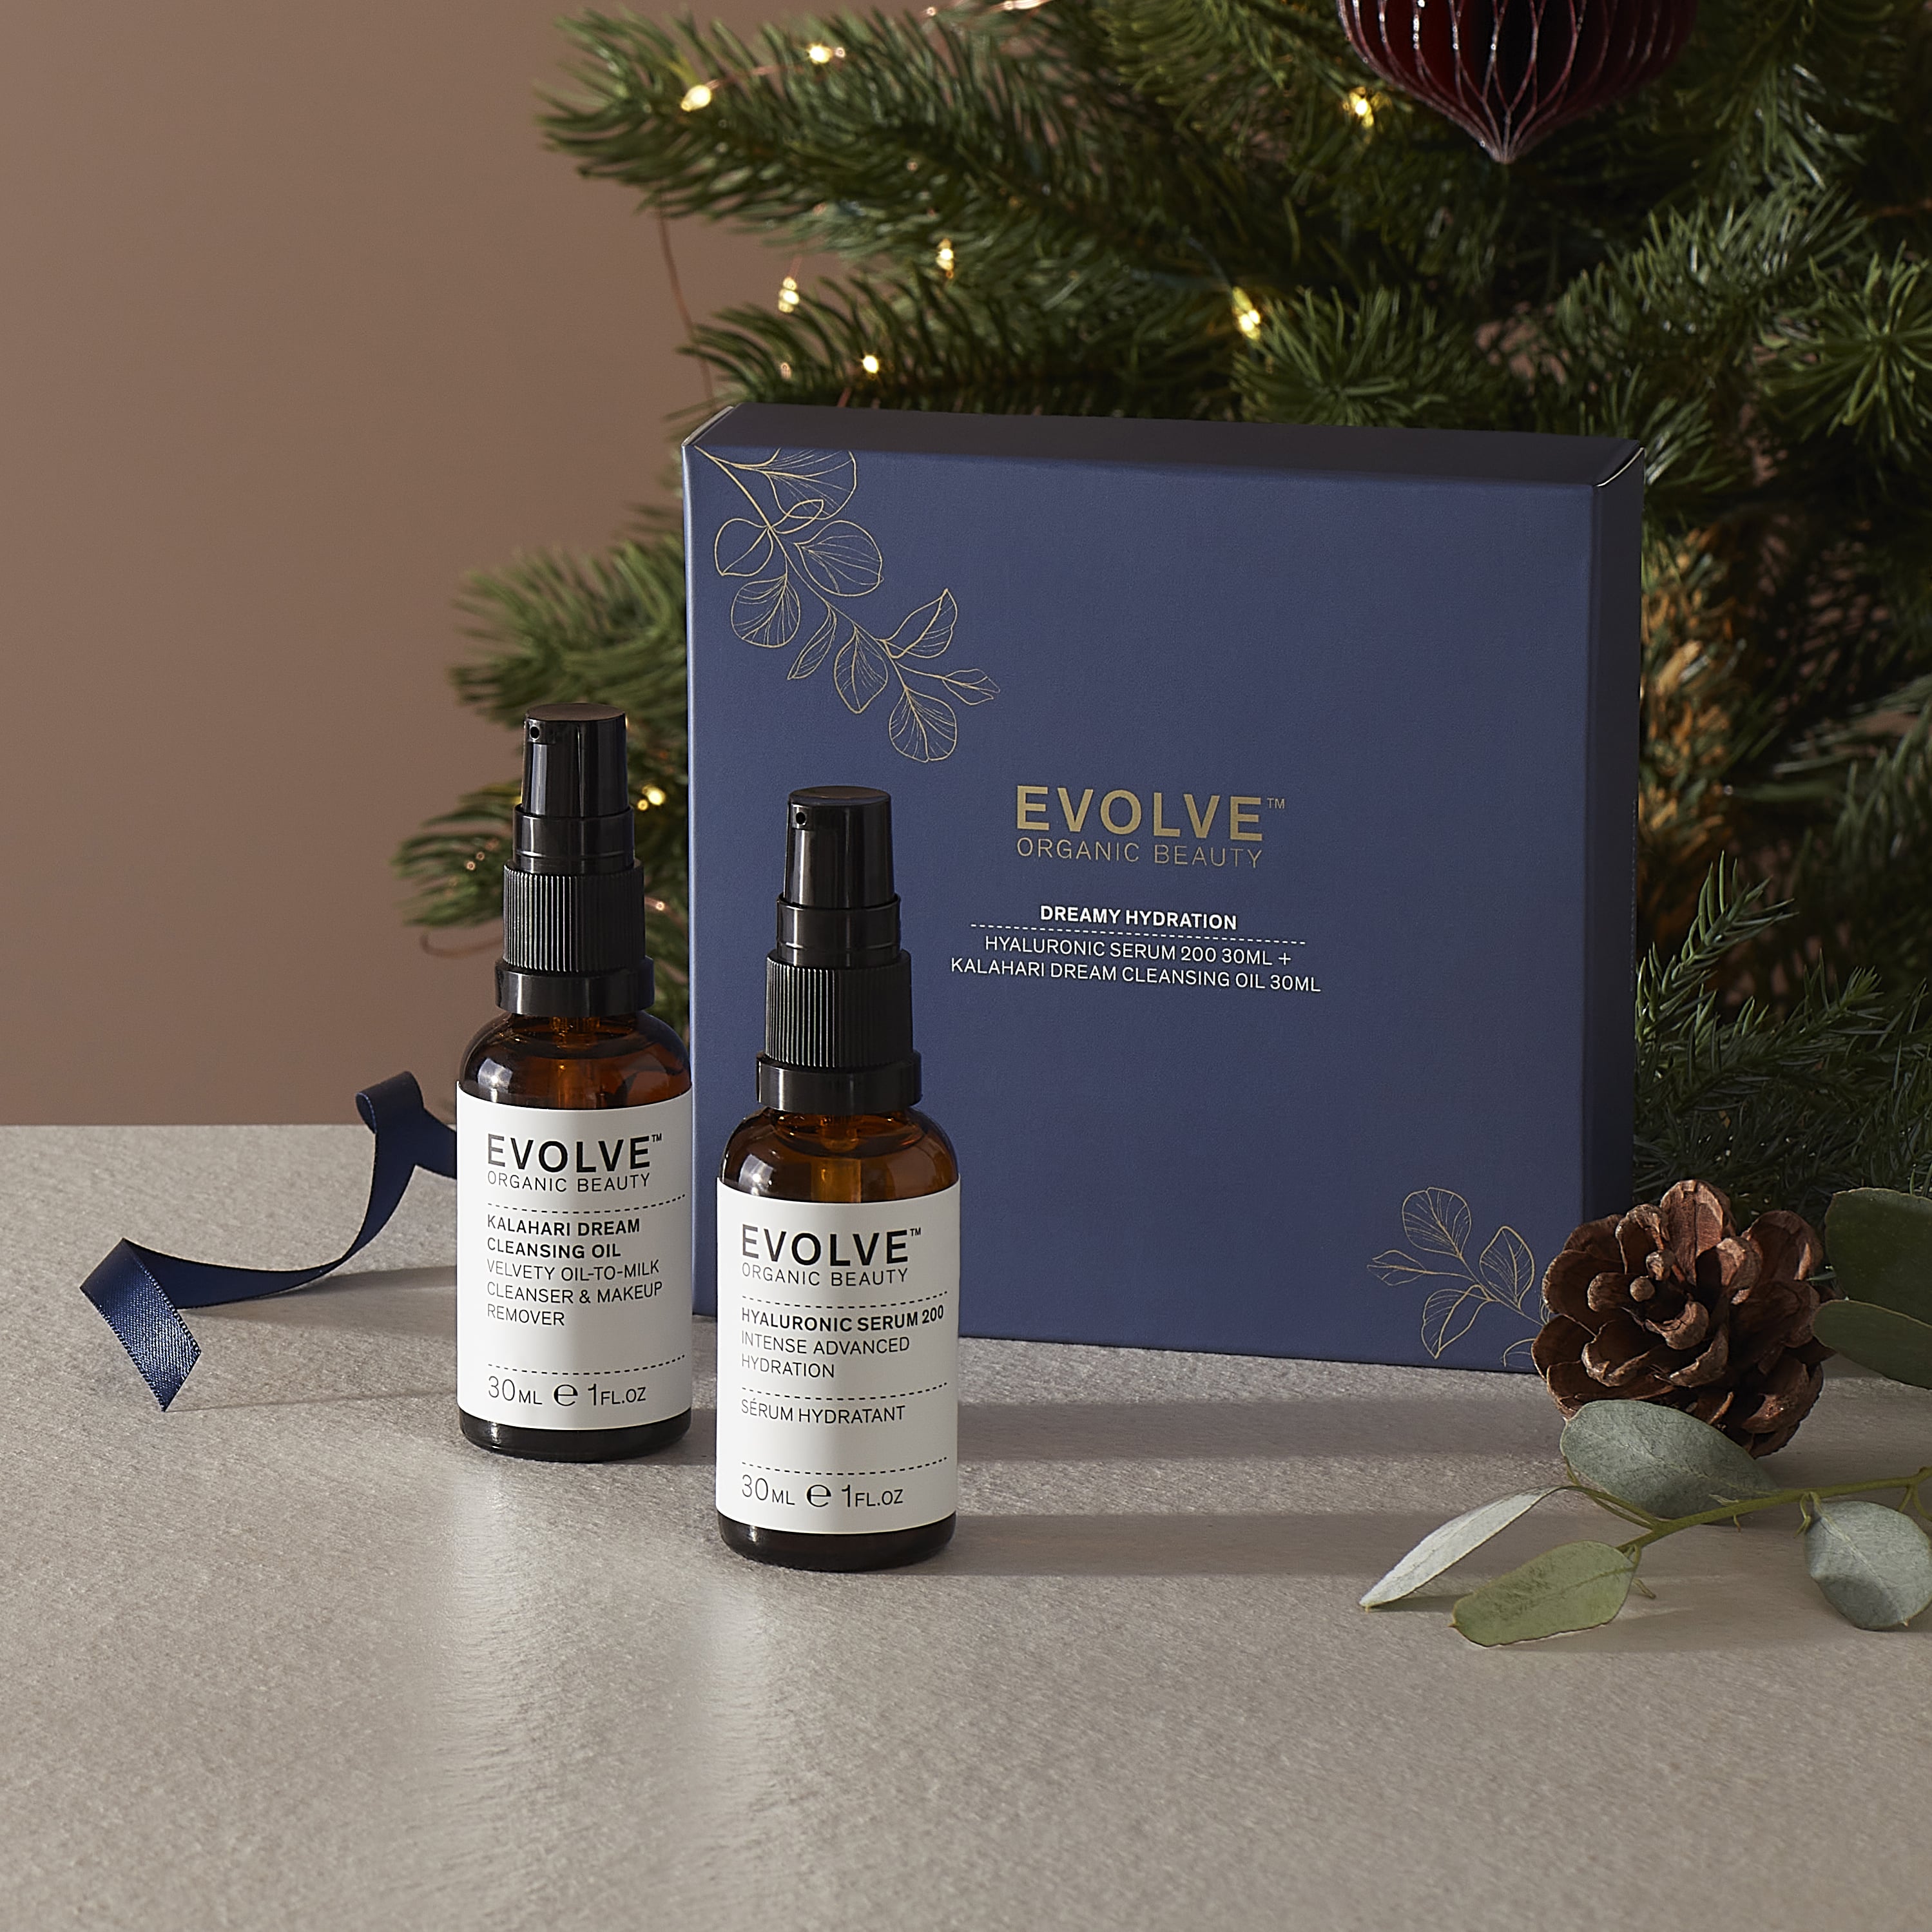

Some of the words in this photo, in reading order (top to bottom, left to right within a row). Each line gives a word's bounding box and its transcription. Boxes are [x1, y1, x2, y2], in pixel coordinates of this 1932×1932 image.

[1016, 836, 1140, 862] ORGANIC
[1154, 844, 1263, 869] BEAUTY
[1039, 905, 1122, 924] DREAMY
[1125, 909, 1238, 931] HYDRATION
[985, 935, 1106, 957] HYALURONIC
[1109, 942, 1176, 961] SERUM
[1180, 945, 1217, 963] 200
[1221, 948, 1273, 966] 30ML
[1278, 952, 1292, 966] +
[951, 958, 1045, 978] KALAHARI
[1050, 963, 1117, 981] DREAM
[1121, 967, 1231, 987] CLEANSING
[1235, 974, 1266, 989] OIL
[1270, 976, 1322, 992] 30ML
[487, 1170, 568, 1193] ORGANIC
[577, 1172, 651, 1193] BEAUTY
[487, 1213, 571, 1237] KALAHARI
[577, 1218, 641, 1237] DREAM
[487, 1237, 585, 1259] CLEANSING
[591, 1243, 622, 1259] OIL
[487, 1259, 556, 1281] VELVETY
[560, 1259, 660, 1282] OIL-TO-MILK
[742, 1262, 821, 1287] ORGANIC
[830, 1267, 909, 1287] BEAUTY
[487, 1281, 574, 1304] CLEANSER
[578, 1290, 592, 1304] &
[597, 1280, 663, 1304] MAKEUP
[487, 1303, 565, 1326] REMOVER
[741, 1307, 853, 1333] HYALURONIC
[856, 1313, 919, 1332] SERUM
[922, 1304, 944, 1325] 200
[741, 1330, 807, 1355] INTENSE
[813, 1336, 910, 1356] ADVANCED
[741, 1353, 835, 1378] HYDRATION
[487, 1375, 543, 1406] 30ML
[587, 1383, 647, 1407] 1FL.OZ
[741, 1397, 794, 1422] SÉRUM
[798, 1405, 906, 1424] HYDRATANT
[741, 1474, 795, 1506] 30ML
[840, 1483, 904, 1508] 1FL.OZ
